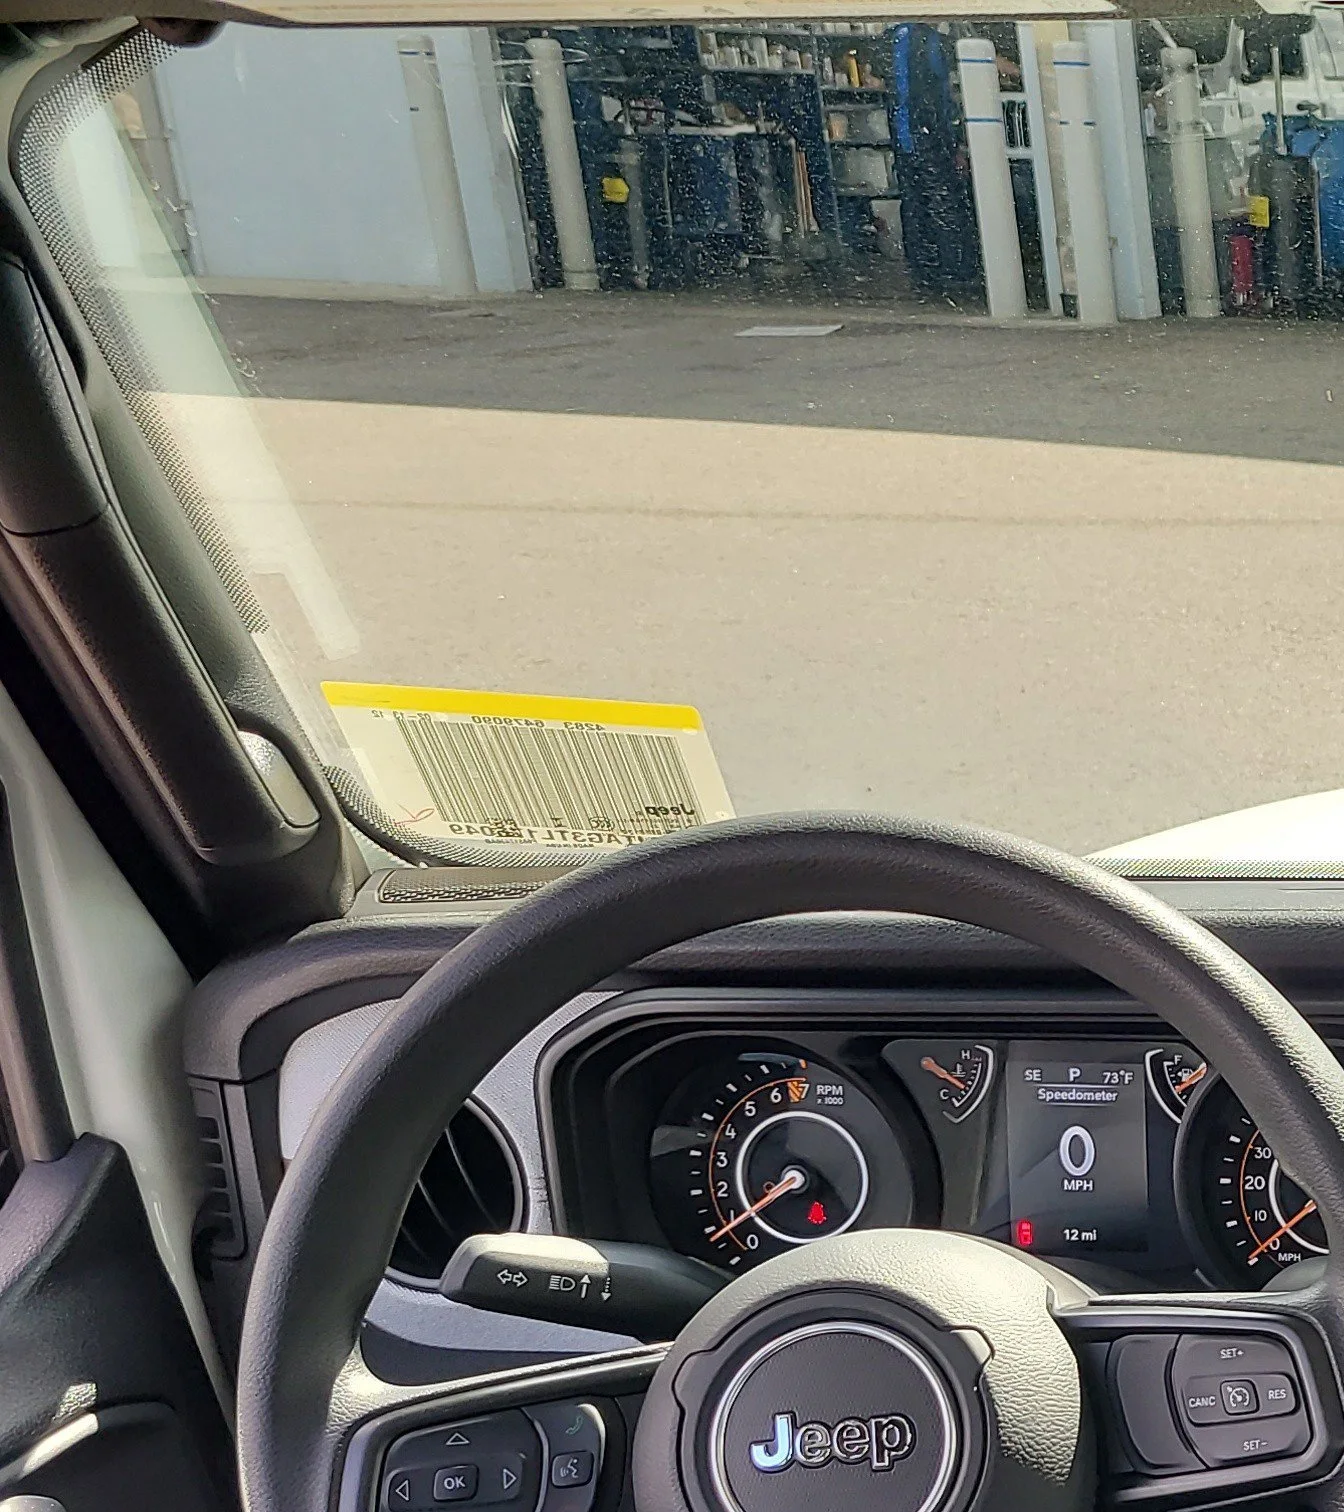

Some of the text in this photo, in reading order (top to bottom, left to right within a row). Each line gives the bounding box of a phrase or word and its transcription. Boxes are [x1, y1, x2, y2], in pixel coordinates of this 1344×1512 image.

[1174, 1055, 1182, 1065] F
[1024, 1068, 1134, 1085] SE P 73°F
[770, 1088, 782, 1103] 6
[799, 1083, 810, 1099] 7
[816, 1084, 843, 1096] RPM
[940, 1089, 949, 1100] C
[1038, 1088, 1118, 1102] Speedometer
[744, 1101, 756, 1117] 5
[725, 1124, 737, 1139] 4
[1059, 1125, 1095, 1177] 0
[1254, 1148, 1272, 1160] 30
[716, 1152, 728, 1167] 3
[716, 1182, 729, 1197] 2
[1063, 1180, 1093, 1191] MPH
[1244, 1175, 1266, 1191] 20
[1254, 1210, 1267, 1222] 10
[1063, 1229, 1097, 1241] 12 mi
[746, 1235, 759, 1250] 0
[1270, 1239, 1281, 1251] 0
[1278, 1252, 1301, 1263] MPH
[1268, 1388, 1287, 1400] RES
[1188, 1396, 1216, 1408] CANC
[751, 1412, 916, 1472] Jeep
[444, 1476, 465, 1490] OK
